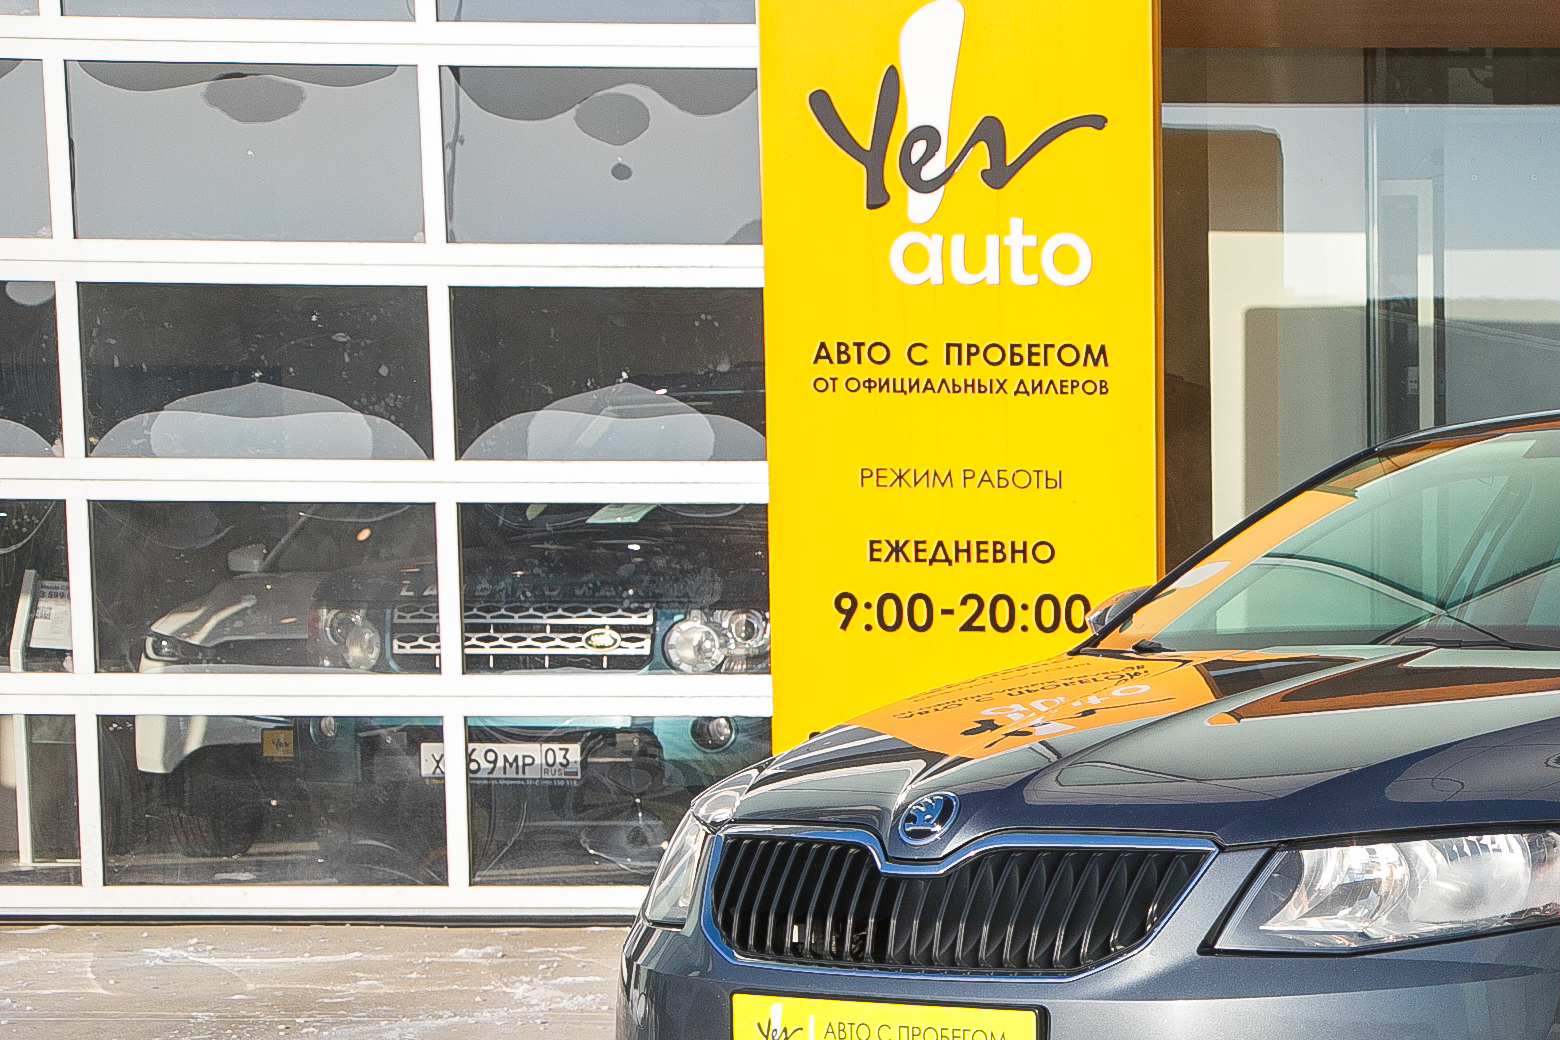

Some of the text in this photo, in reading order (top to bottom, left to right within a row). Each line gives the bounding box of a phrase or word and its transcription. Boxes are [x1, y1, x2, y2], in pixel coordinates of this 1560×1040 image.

[808, 64, 1108, 210] Yes
[889, 217, 1093, 287] auto
[812, 341, 1109, 367] АВТО С ПРОБЕГОМ
[812, 377, 1109, 396] ОТ ОФИЦИАЛЬНЫХ ДИЛЕРОВ
[860, 468, 1063, 490] РЕЖИМ РАБОТЫ
[868, 539, 1056, 566] ЕЖЕДНЕВНО
[833, 592, 1091, 633] 9:00-20:00
[544, 747, 570, 768] 03
[543, 768, 564, 777] RUS
